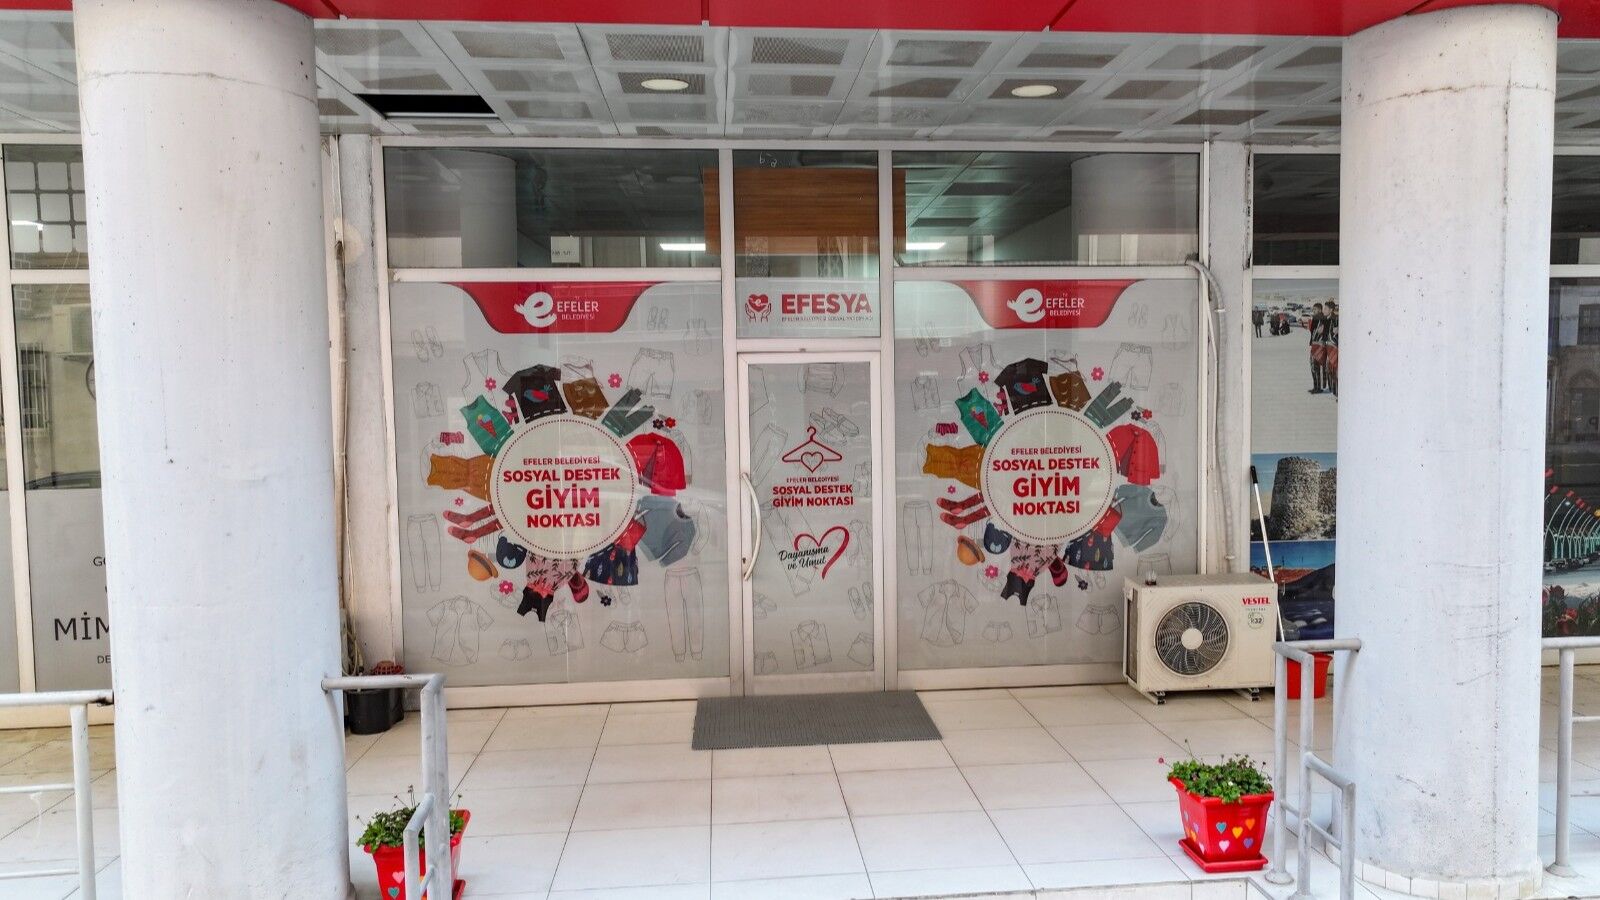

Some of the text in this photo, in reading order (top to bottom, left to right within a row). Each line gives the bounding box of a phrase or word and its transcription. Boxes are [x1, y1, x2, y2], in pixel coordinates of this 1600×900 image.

[556, 301, 599, 313] EFELER
[781, 293, 872, 315] EFESYA
[1046, 298, 1085, 309] EFELER
[1011, 445, 1082, 456] EFELER BELEDİYESİ
[523, 455, 600, 466] EFELER BELEDİYESİ
[993, 457, 1100, 472] SOSYAL DESTEK
[503, 468, 621, 482] SOSYAL DESTEK
[773, 484, 853, 495] SOSYAL DESTEK
[1012, 472, 1080, 498] GİYİM
[526, 483, 600, 510] GİYİM
[773, 496, 854, 508] GİYİM NOKTASI
[1012, 501, 1080, 516] NOKTASI
[527, 513, 600, 528] NOKTASI
[787, 562, 797, 570] ve
[1242, 597, 1271, 605] VESTEL
